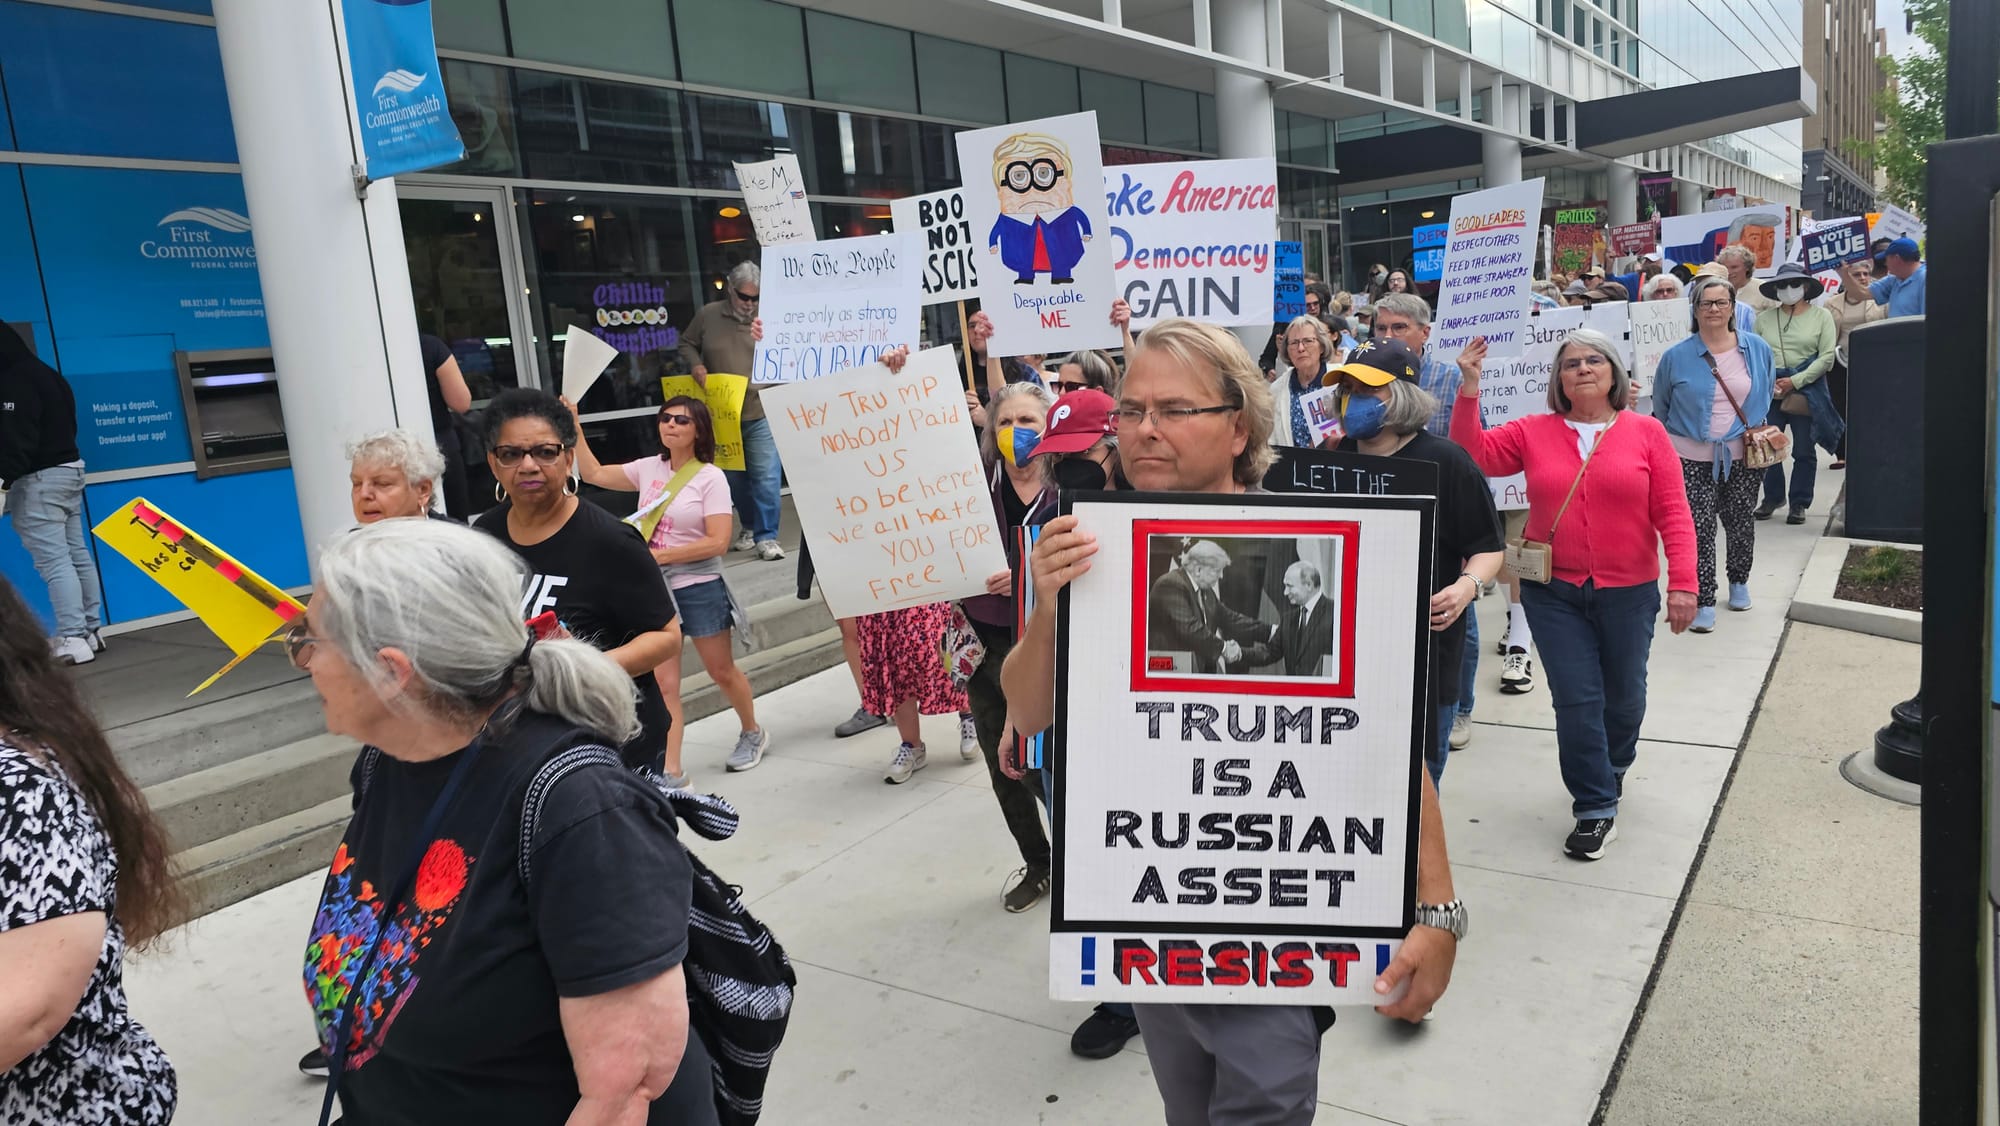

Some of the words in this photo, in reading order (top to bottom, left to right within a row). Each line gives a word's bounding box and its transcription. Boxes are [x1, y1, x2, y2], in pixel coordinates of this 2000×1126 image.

[366, 94, 440, 128] Commonwealth
[378, 94, 398, 111] First
[1160, 170, 1276, 214] America
[1454, 215, 1481, 232] GOOD
[1482, 210, 1525, 228] LEADERS
[1557, 209, 1596, 224] FAMILIES
[170, 227, 211, 242] First
[927, 221, 972, 251] NOT
[1452, 237, 1486, 253] RESPECT
[1485, 235, 1520, 247] OTHERS
[1819, 227, 1852, 244] VOTE
[1110, 225, 1268, 274] Democracy
[1448, 260, 1470, 273] FEED
[1472, 257, 1488, 269] THE
[1488, 252, 1522, 265] HUNGRY
[1808, 234, 1865, 265] BLUE
[782, 257, 804, 280] We
[812, 253, 839, 279] The
[845, 248, 897, 280] People
[1445, 274, 1483, 288] WELCOME
[1485, 267, 1529, 283] STRANGERS
[1013, 289, 1086, 316] Despicable
[1124, 276, 1240, 319] GAIN
[1451, 292, 1472, 306] HELP
[1473, 289, 1489, 301] THE
[1490, 285, 1516, 297] POOR
[783, 311, 806, 325] are
[808, 304, 834, 329] only
[838, 310, 853, 323] as
[857, 299, 897, 325] strong
[1041, 310, 1071, 329] ME
[1441, 315, 1479, 330] EMBRACE
[1480, 310, 1520, 323] OUTCASTS
[775, 332, 791, 346] as
[794, 330, 816, 344] our
[818, 328, 865, 344] weakest
[867, 322, 888, 343] link
[1439, 335, 1470, 349] DIGNIFY
[1635, 321, 1689, 344] DEMOCRACY
[92, 403, 120, 413] Making
[129, 400, 158, 412] deposit,
[95, 416, 126, 426] transfer
[138, 412, 172, 425] payment?
[786, 401, 828, 431] Hey
[908, 405, 960, 433] Paid
[98, 435, 136, 445] Download
[137, 433, 149, 442] our
[151, 430, 167, 442] app!
[863, 449, 908, 478] US
[1293, 459, 1344, 492] LET
[836, 495, 868, 518] to
[877, 483, 914, 508] be
[918, 463, 982, 499] here!
[874, 515, 909, 535] all
[916, 495, 980, 526] hate
[881, 535, 935, 567] YOU
[949, 523, 992, 550] FOR
[140, 552, 170, 573] has
[1135, 702, 1360, 745] TRUMP
[1192, 758, 1252, 797] IS
[1267, 760, 1306, 799] A
[1105, 810, 1384, 856] RUSSIAN
[1131, 865, 1355, 908] ASSET
[1113, 938, 1361, 988] RESIST
